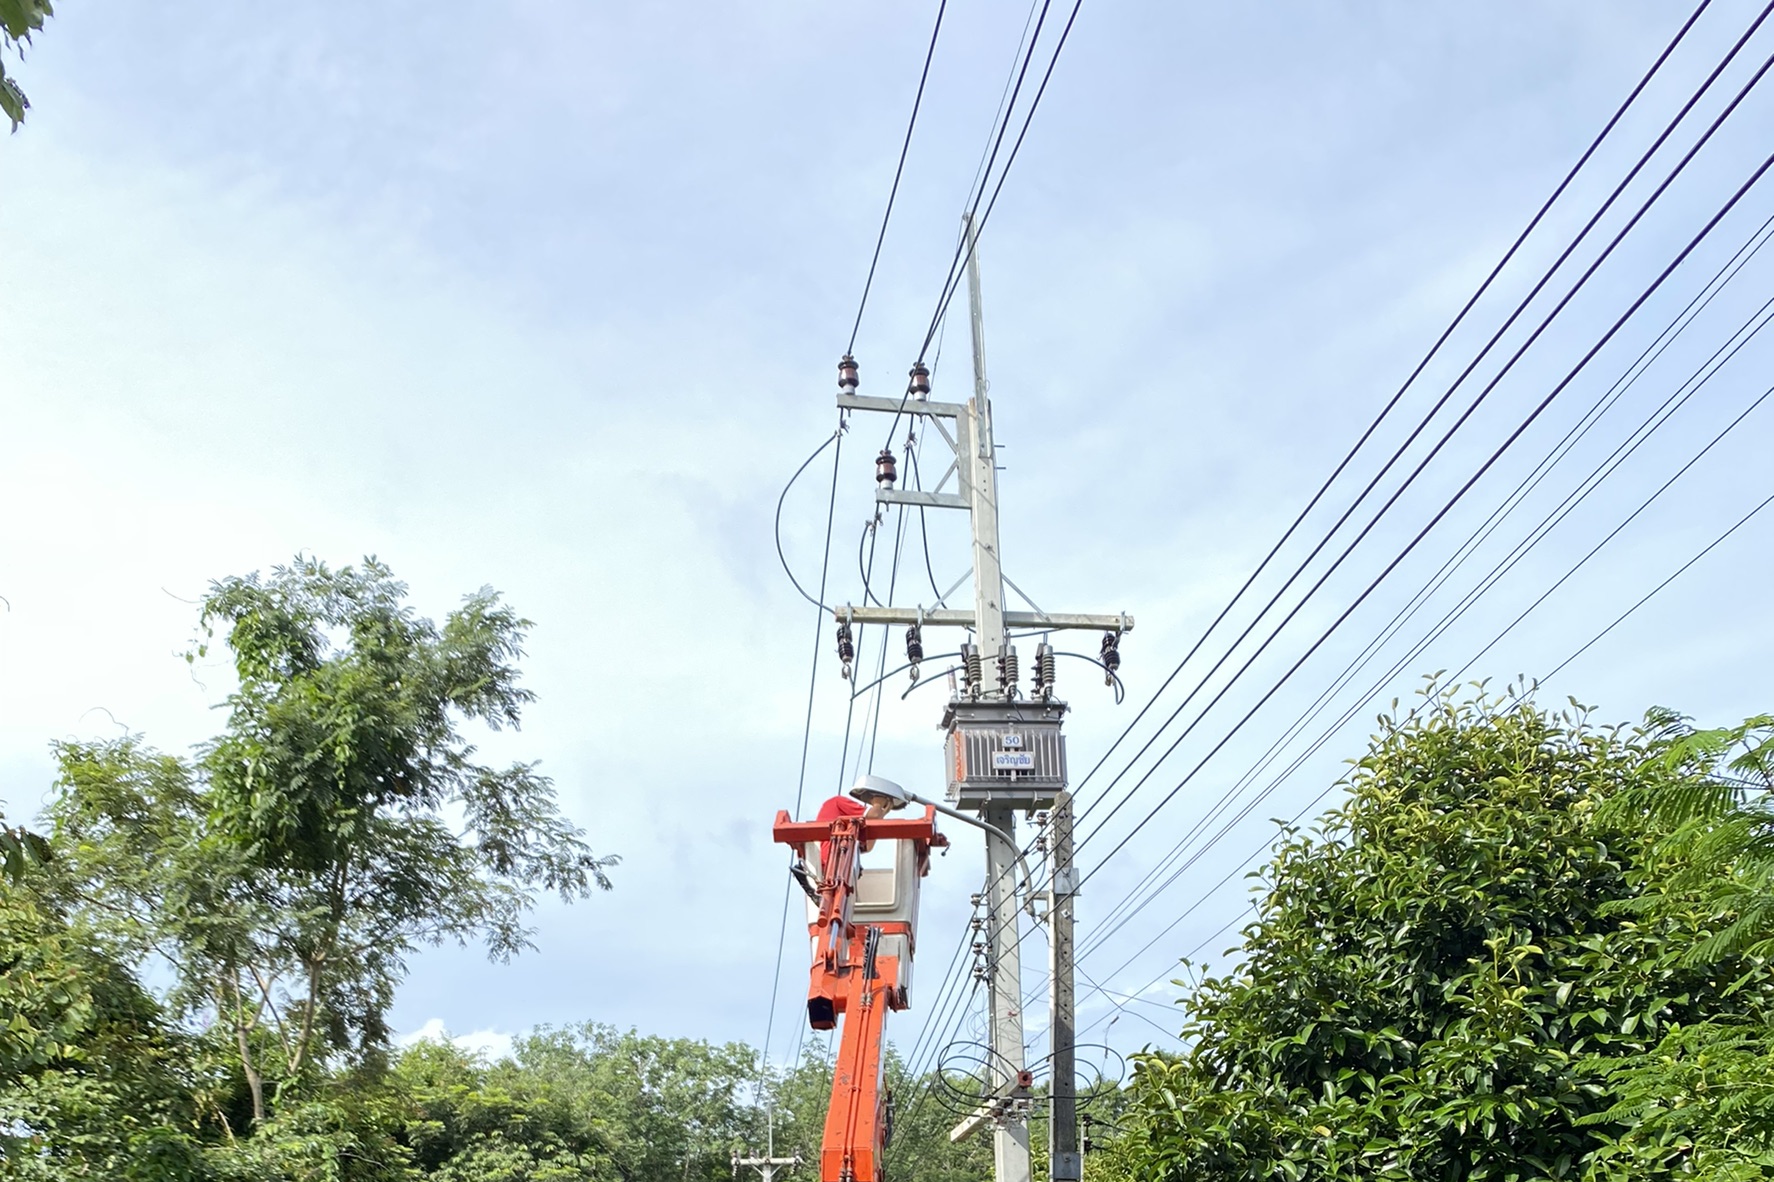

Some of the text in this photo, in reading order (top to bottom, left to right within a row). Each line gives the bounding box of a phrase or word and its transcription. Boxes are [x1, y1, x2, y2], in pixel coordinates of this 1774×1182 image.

[1005, 736, 1020, 745] 50
[996, 754, 1031, 767] เจริญชัย
